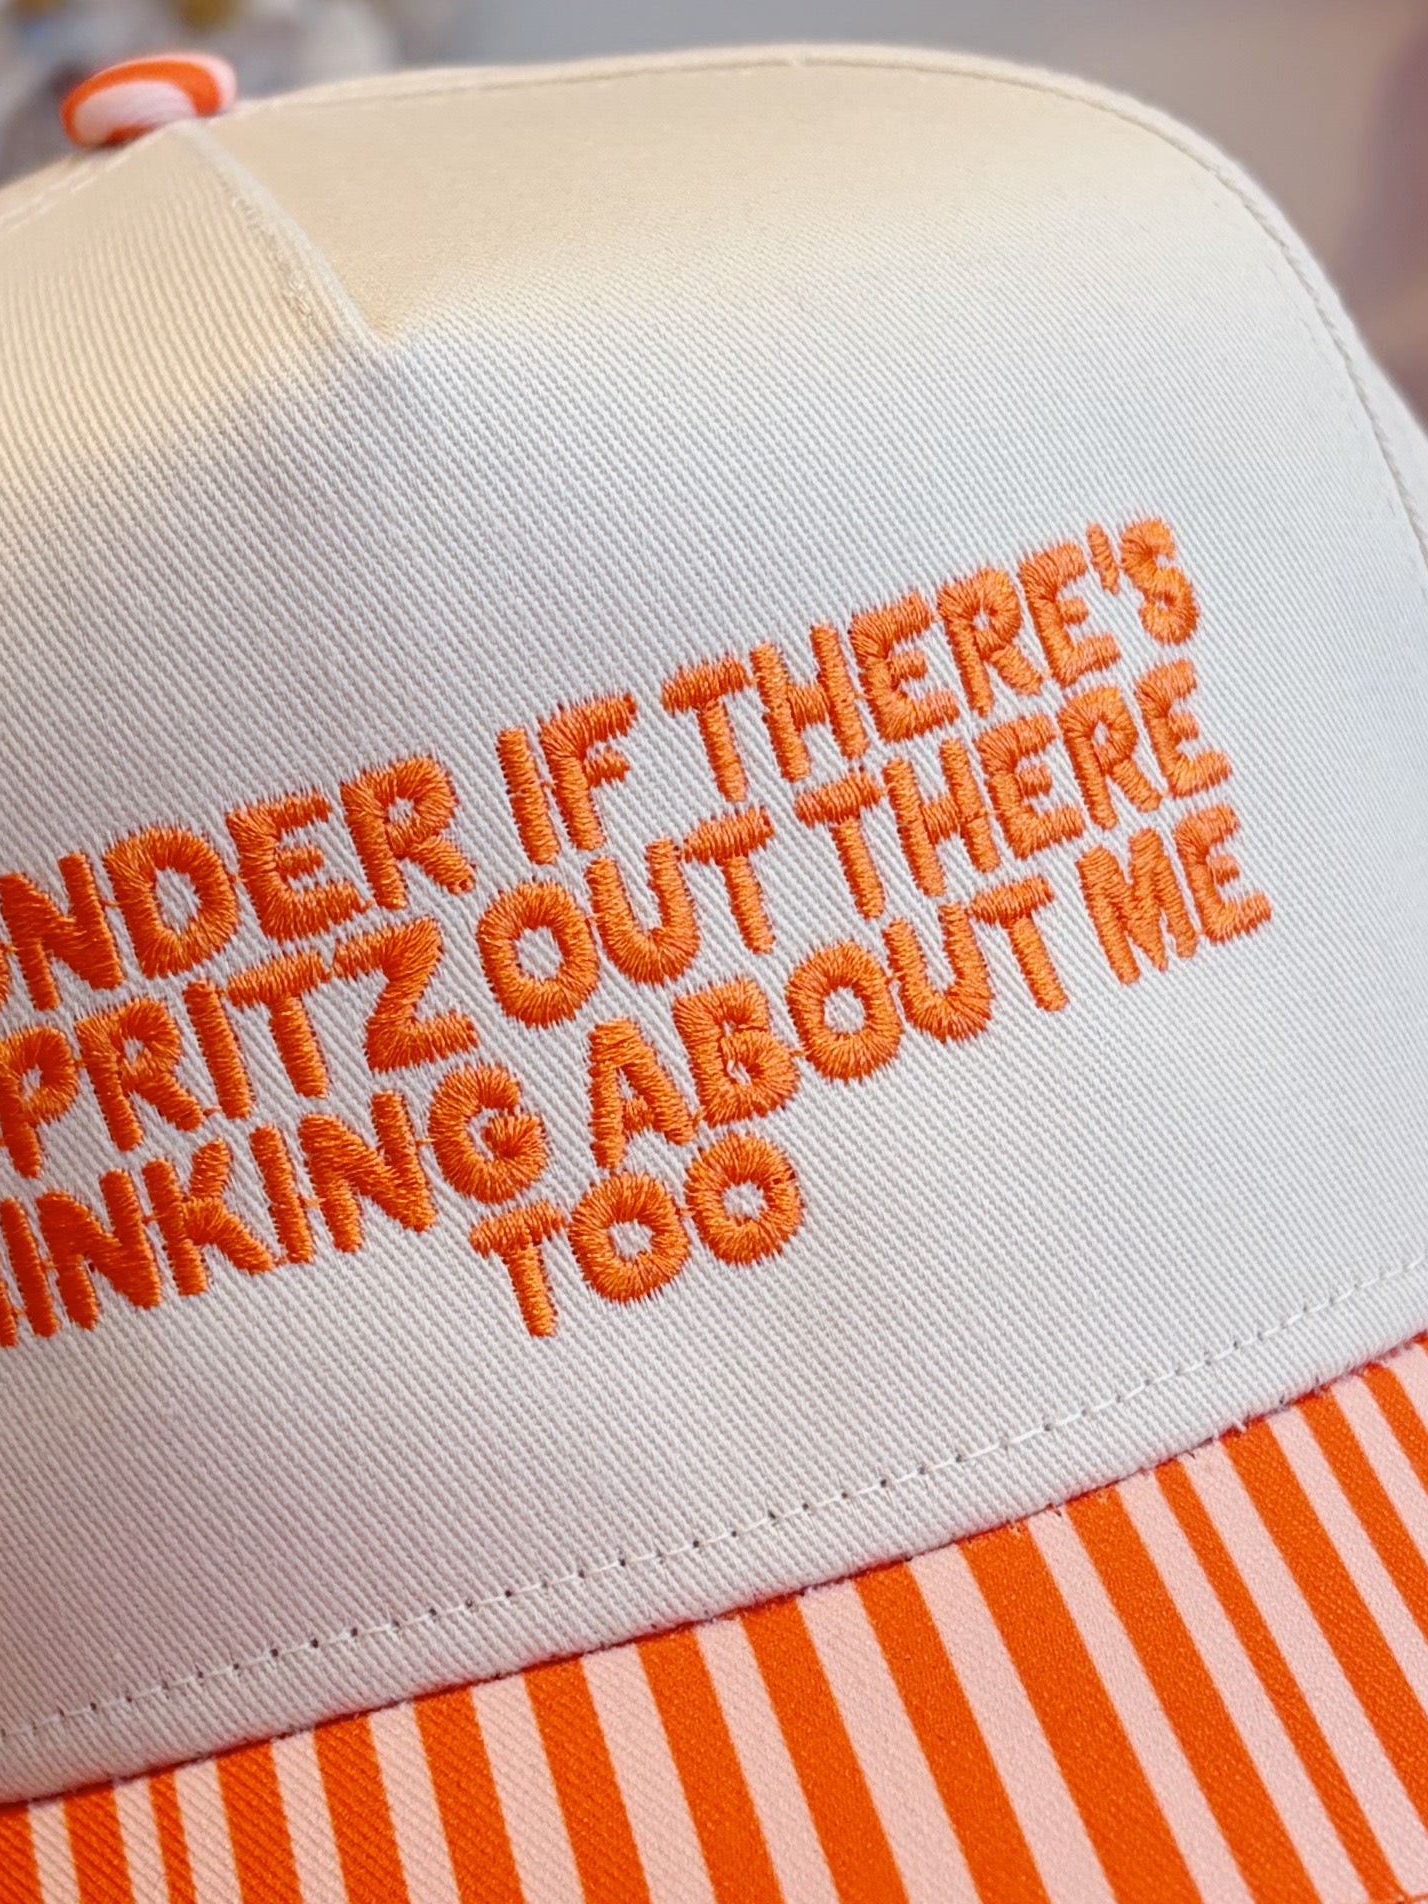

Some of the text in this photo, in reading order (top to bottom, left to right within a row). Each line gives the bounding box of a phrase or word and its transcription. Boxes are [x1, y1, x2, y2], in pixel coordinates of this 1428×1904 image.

[476, 807, 774, 1028] OUT
[795, 660, 1232, 920] THERE
[497, 694, 637, 865] IF
[661, 516, 1200, 802] THERE'S
[587, 877, 1068, 1169] ABOUT
[1076, 805, 1271, 985] ME
[469, 1132, 804, 1337] TOO
